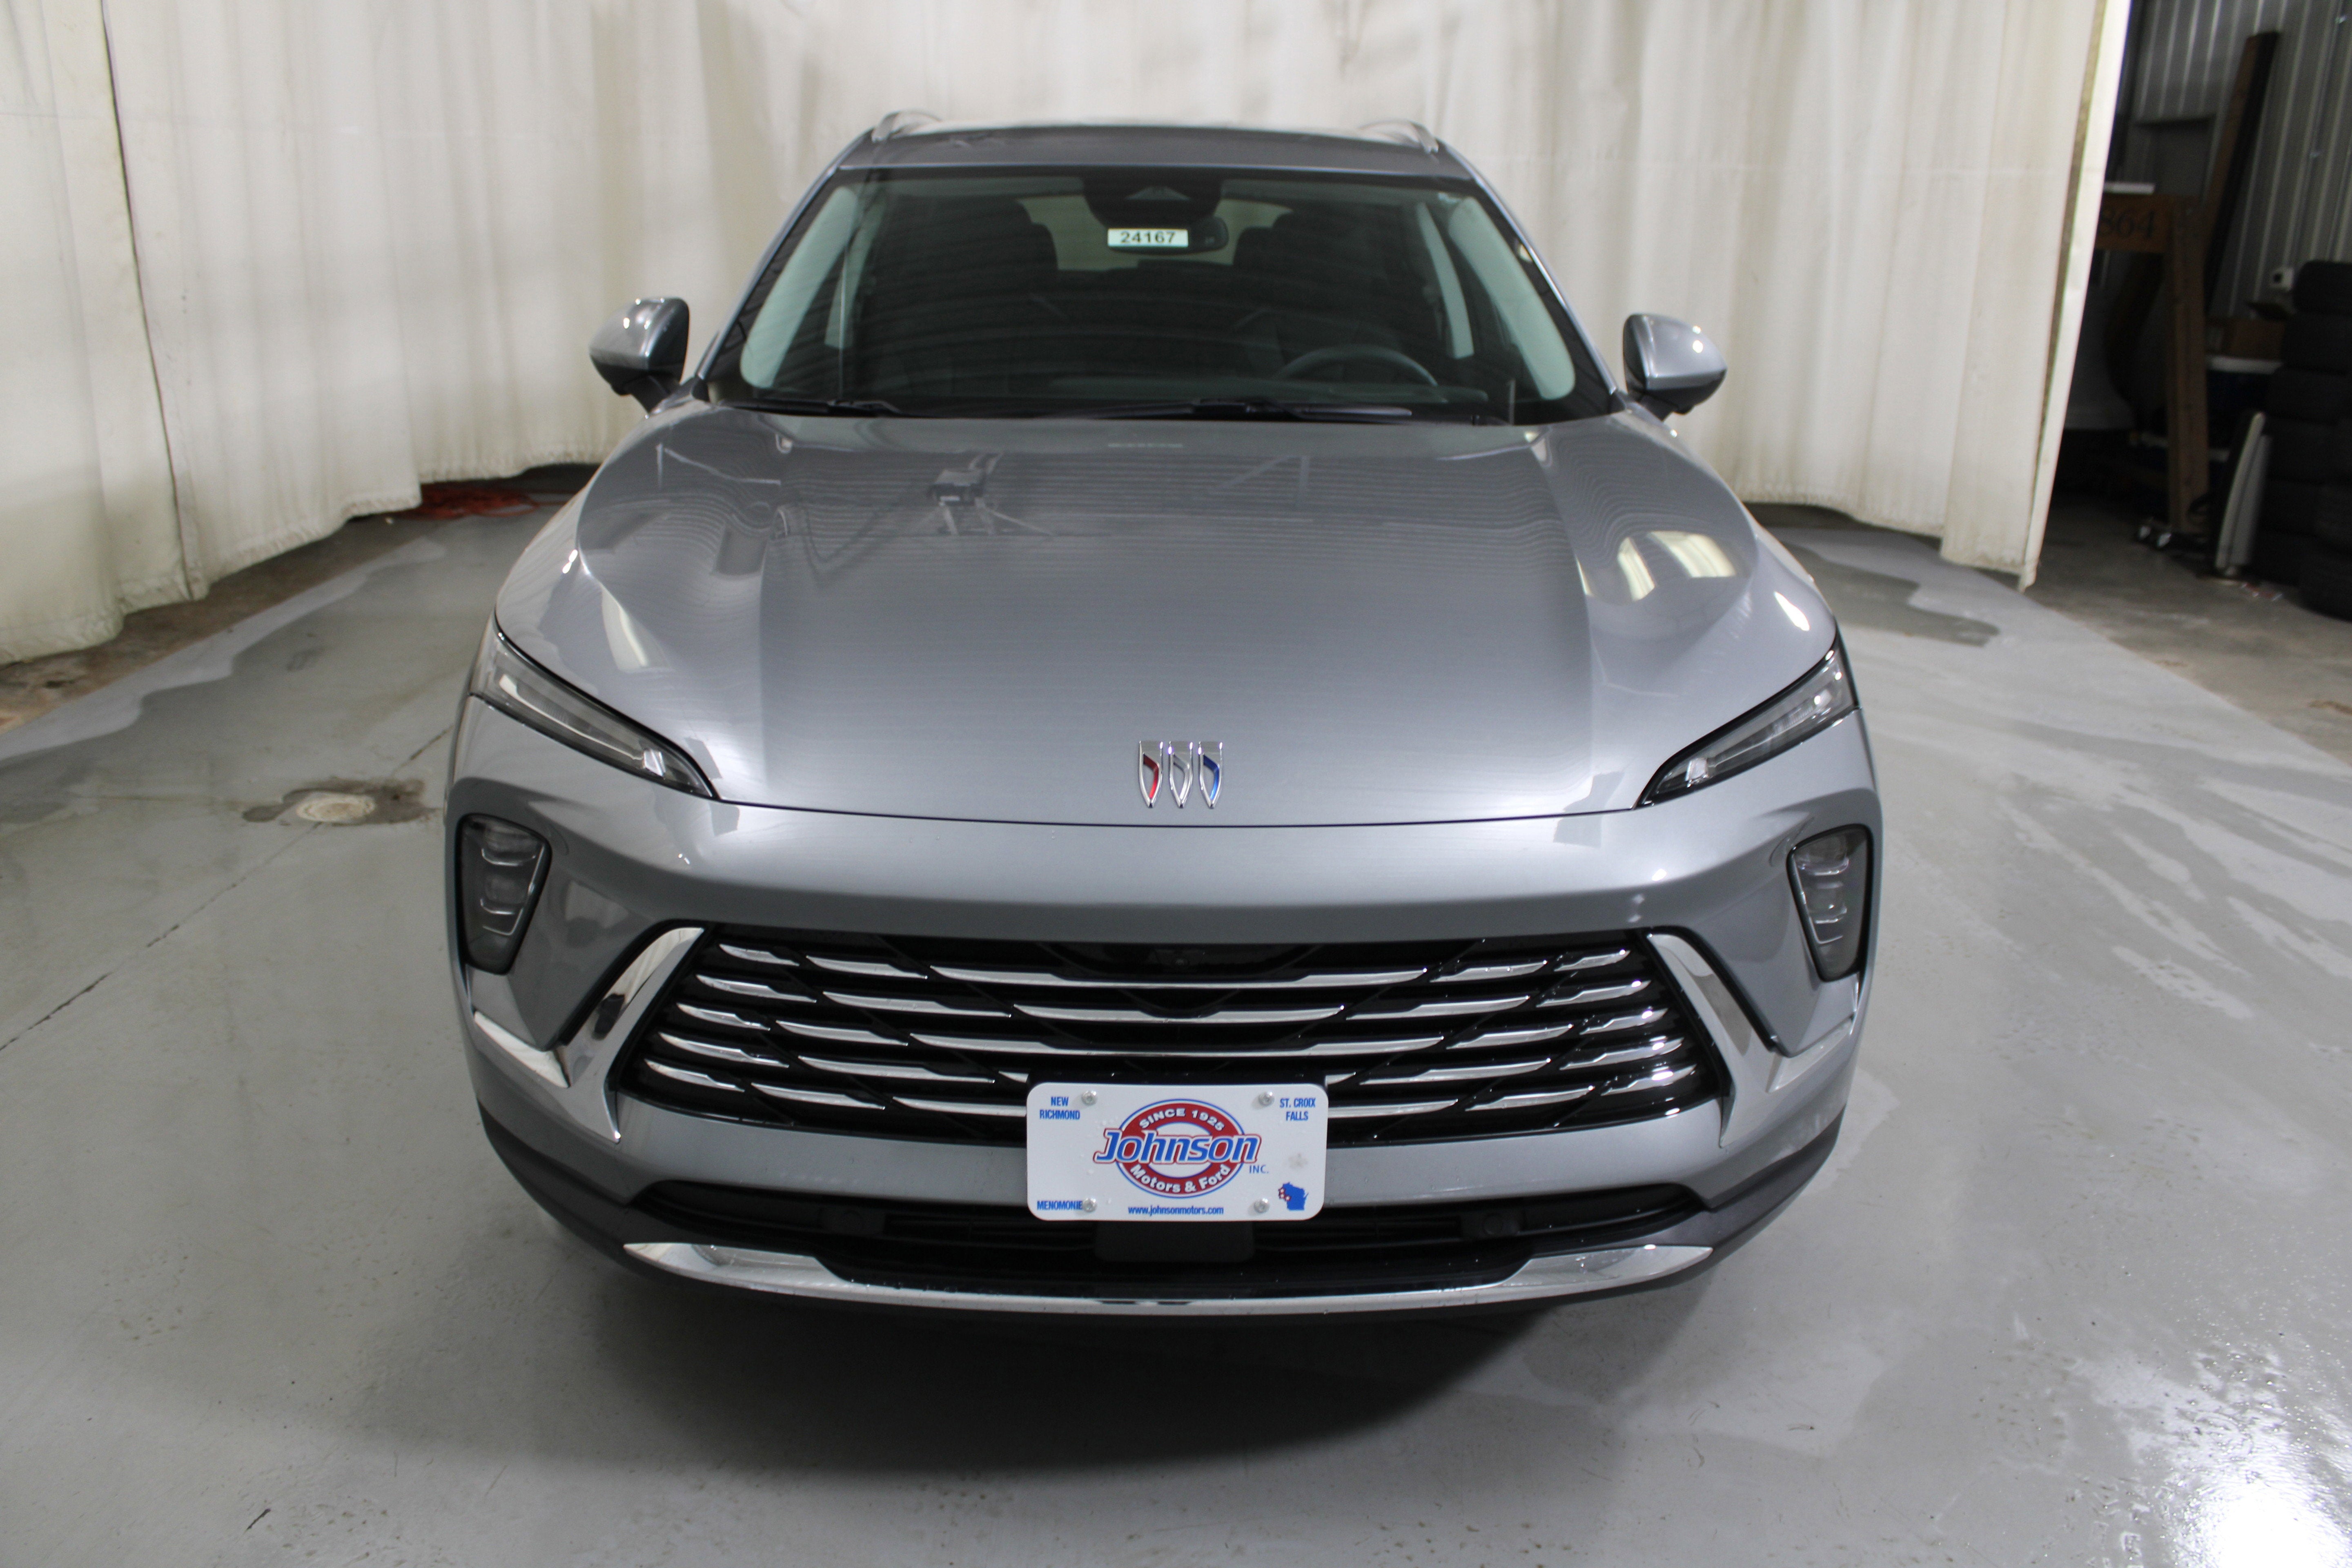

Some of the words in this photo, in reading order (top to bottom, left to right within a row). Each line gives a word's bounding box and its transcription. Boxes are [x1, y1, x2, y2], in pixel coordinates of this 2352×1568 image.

[1120, 230, 1176, 244] 24167
[1051, 1096, 1069, 1106] NEW
[1280, 1098, 1291, 1108] ST.
[1294, 1098, 1316, 1108] CROIX
[1040, 1109, 1080, 1120] RICHMOND
[1139, 1108, 1186, 1129] SINCE
[1192, 1109, 1225, 1131] 1925
[1286, 1111, 1309, 1121] FALLS
[1094, 1130, 1259, 1163] Johnson
[1250, 1165, 1269, 1174] INC.
[1130, 1164, 1181, 1193] Motors
[1184, 1180, 1197, 1193] &
[1198, 1164, 1231, 1190] Ford
[1037, 1200, 1083, 1211] MENOMONIE
[1128, 1205, 1224, 1217] www.johnsonmotors.com
